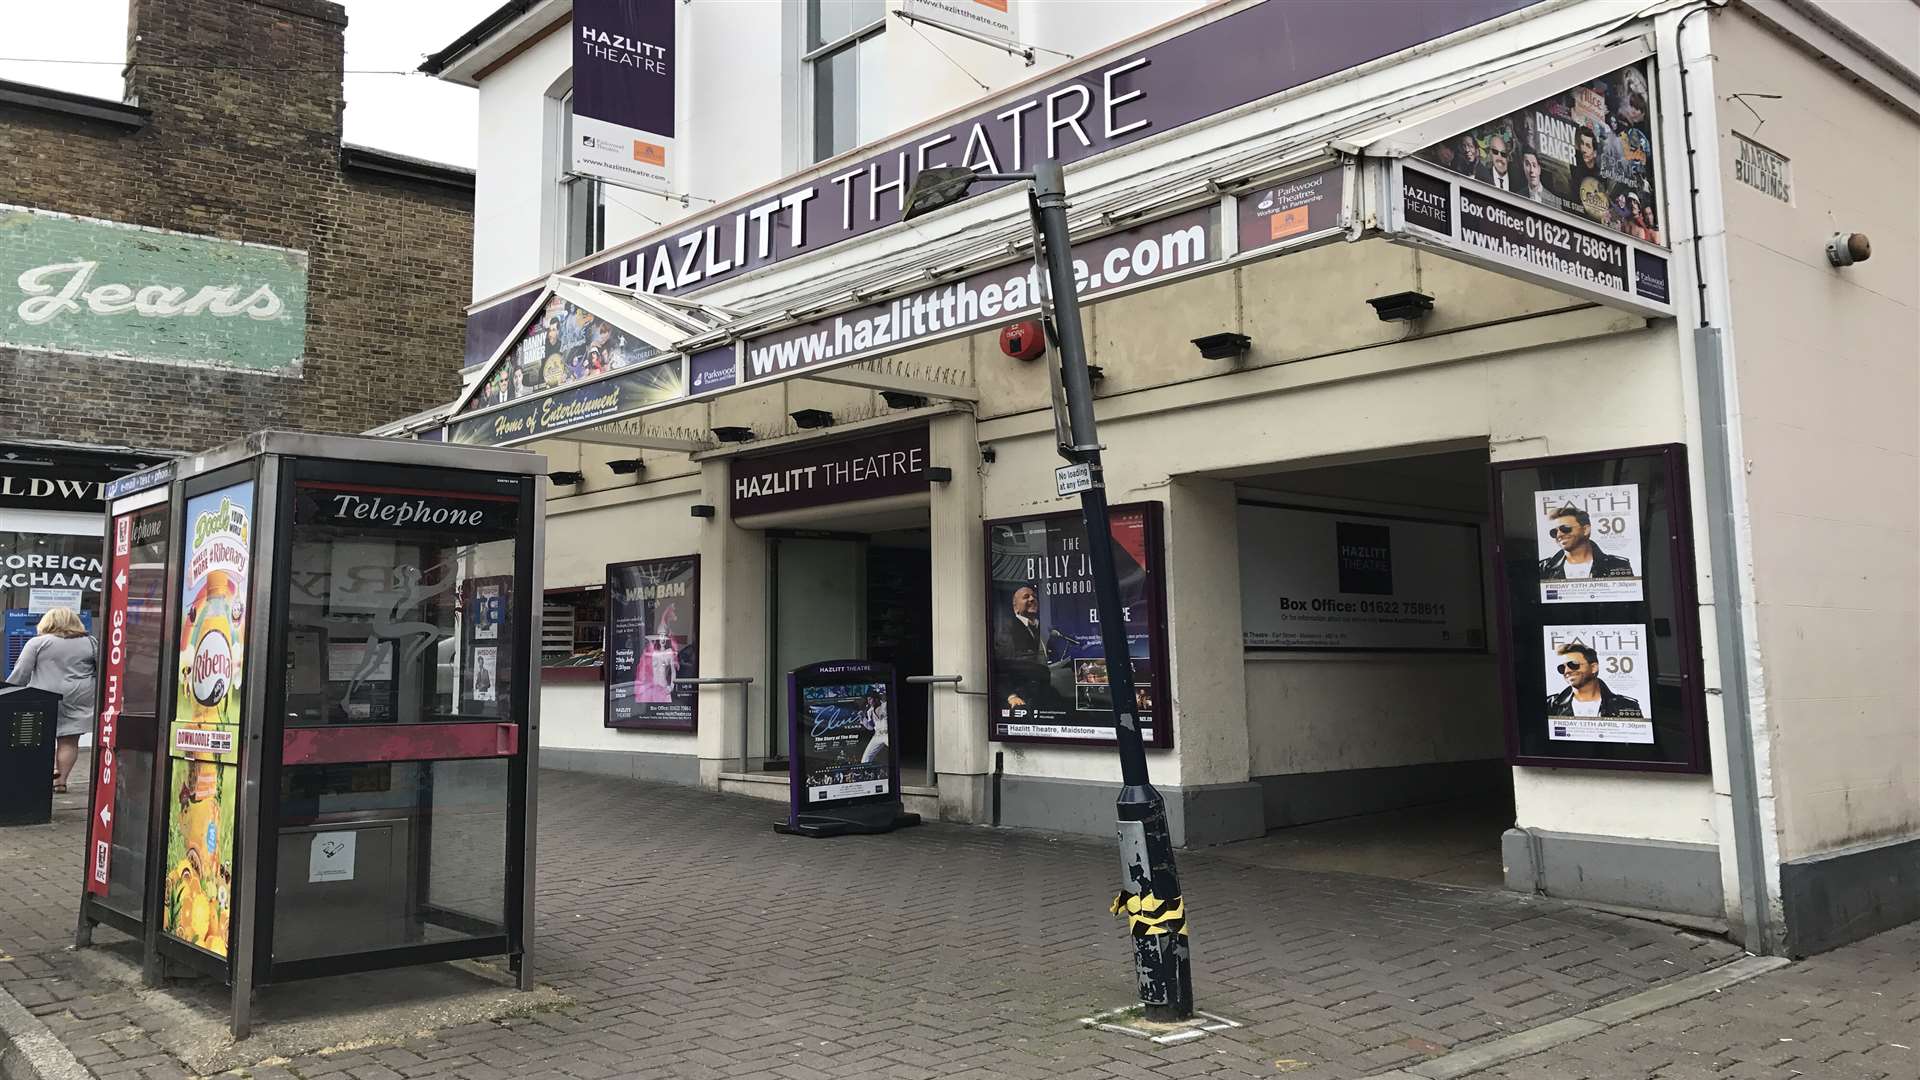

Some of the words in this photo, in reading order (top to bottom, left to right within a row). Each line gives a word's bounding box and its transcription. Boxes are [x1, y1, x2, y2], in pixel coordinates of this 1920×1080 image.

[582, 26, 666, 60] HAZLITT
[583, 41, 667, 76] THEATRE
[1536, 111, 1577, 143] DANNY
[1539, 134, 1577, 167] BAKER
[1740, 140, 1783, 180] MARKET
[619, 187, 814, 290] HAZLITT
[831, 57, 1149, 229] THEATRE
[1735, 159, 1790, 203] BUILDINGS
[1277, 176, 1323, 197] Parkwood
[1402, 183, 1446, 208] HAZLITT
[1278, 190, 1315, 205] Theatres
[1460, 196, 1483, 219] Box
[1487, 205, 1524, 232] Office:
[1526, 217, 1571, 250] 01622
[1574, 233, 1623, 267] 758611
[1462, 226, 1623, 290] www.hazlitttheatre.com
[18, 261, 284, 325] Jeans
[751, 225, 1205, 376] www.hazlitttheate.com
[523, 332, 547, 351] DANNY
[523, 346, 546, 364] BAKER
[704, 364, 736, 380] Parkwood
[495, 414, 523, 436] Home
[526, 408, 538, 434] of
[541, 387, 620, 426] Entertainment
[735, 466, 817, 500] HAZLITT
[823, 448, 922, 486] THEATRE
[1058, 471, 1067, 480] No
[1068, 468, 1088, 478] loading
[1060, 482, 1066, 490] at
[1067, 482, 1076, 490] any
[1077, 479, 1090, 487] time
[333, 494, 484, 527] Telephone
[1543, 495, 1631, 515] FAITH
[232, 510, 243, 525] YOUR
[1598, 517, 1626, 535] 30
[229, 524, 241, 537] WORLD
[1063, 537, 1080, 551] THE
[1342, 545, 1388, 559] HAZLITT
[193, 558, 208, 578] MORE
[210, 543, 246, 572] #Ribenary
[1027, 555, 1069, 580] BILLY
[1343, 558, 1389, 571] THEATRE
[625, 586, 656, 601] WAM
[656, 582, 685, 599] BAM
[1046, 580, 1096, 596] SONGBOO
[1280, 597, 1306, 611] Box
[1311, 598, 1357, 613] Office:
[1360, 601, 1399, 614] 01622
[1403, 602, 1446, 616] 758611
[112, 610, 123, 665] 300
[1551, 635, 1639, 651] FAITH
[195, 649, 231, 684] Ribena
[1606, 656, 1634, 674] 30
[811, 705, 864, 737] Elvis
[1009, 725, 1031, 733] Hazlitt
[1031, 725, 1060, 735] Theatre,
[1060, 726, 1096, 735] Maidstone
